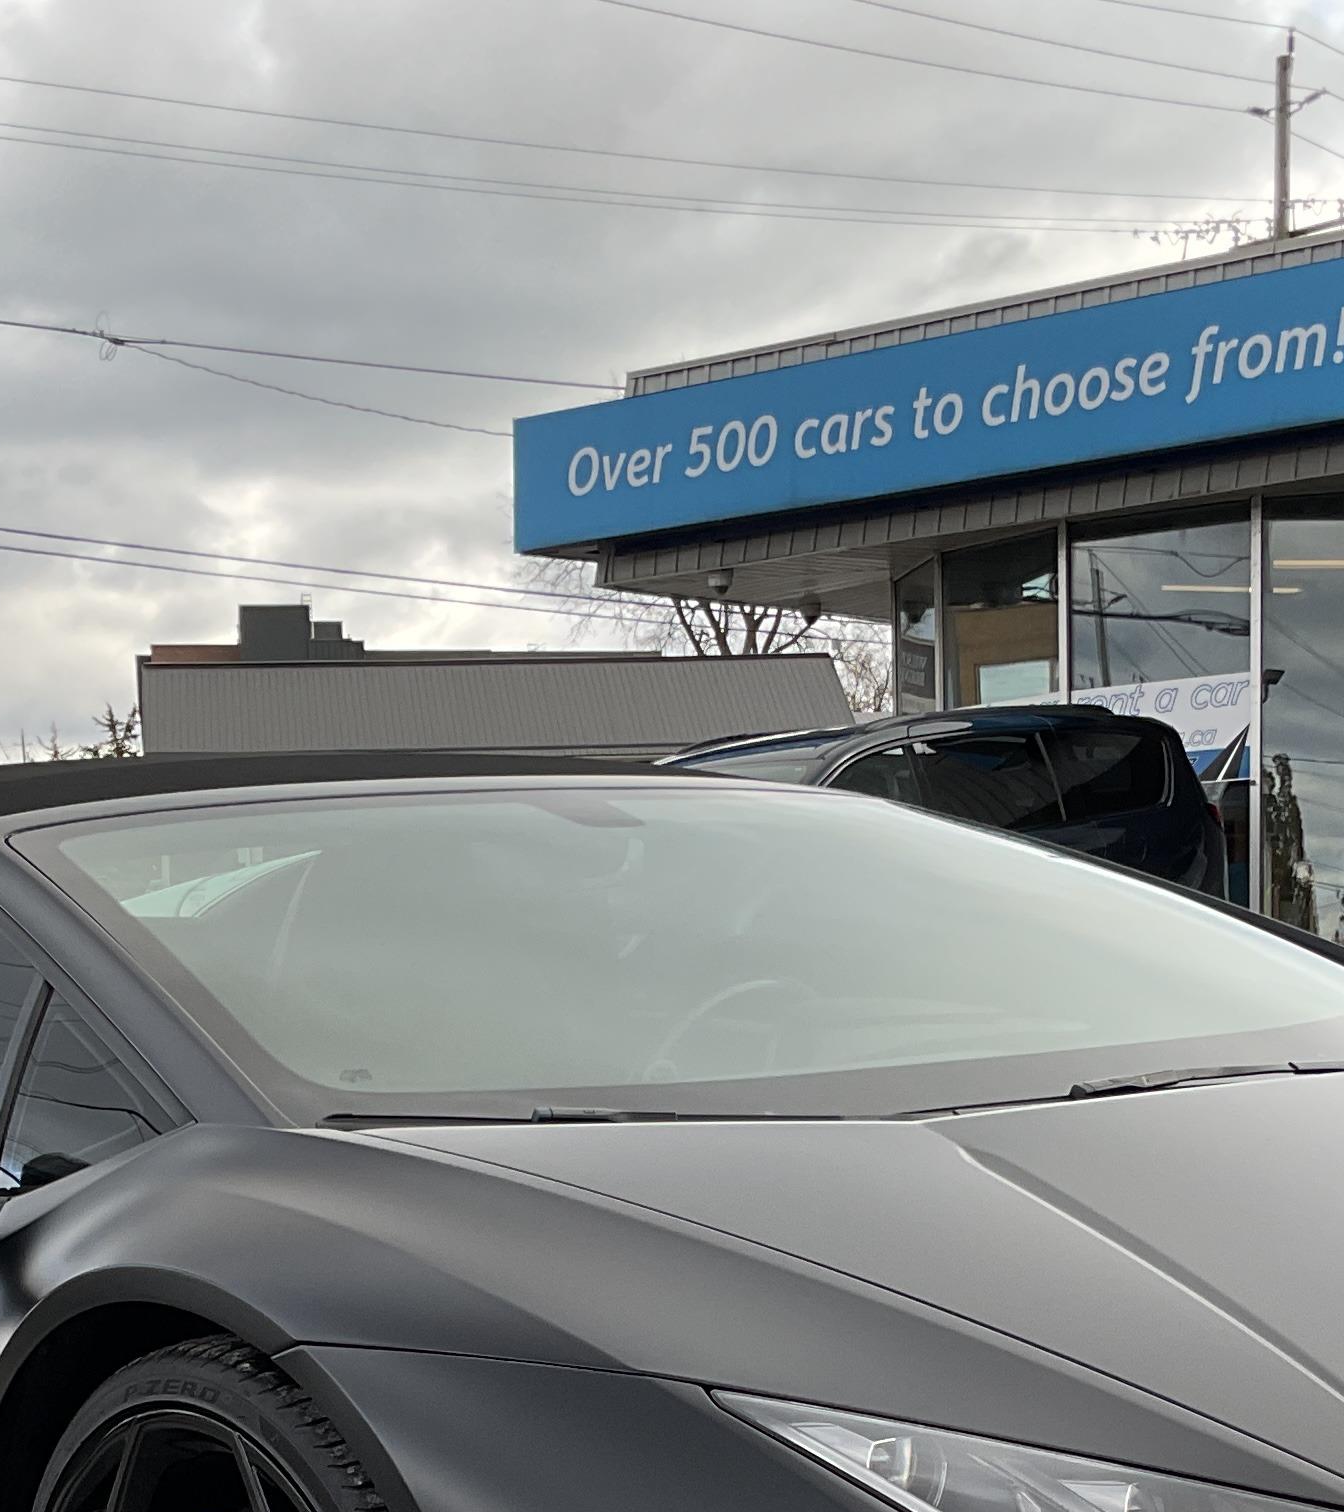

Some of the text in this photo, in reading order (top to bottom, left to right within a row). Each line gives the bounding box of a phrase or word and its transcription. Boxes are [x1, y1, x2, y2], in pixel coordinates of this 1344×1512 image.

[567, 443, 673, 497] Over
[684, 414, 779, 479] 500
[794, 404, 895, 459] cars
[912, 386, 964, 440] to
[981, 352, 1170, 427] choose
[1154, 687, 1179, 714] a
[1190, 680, 1250, 711] car
